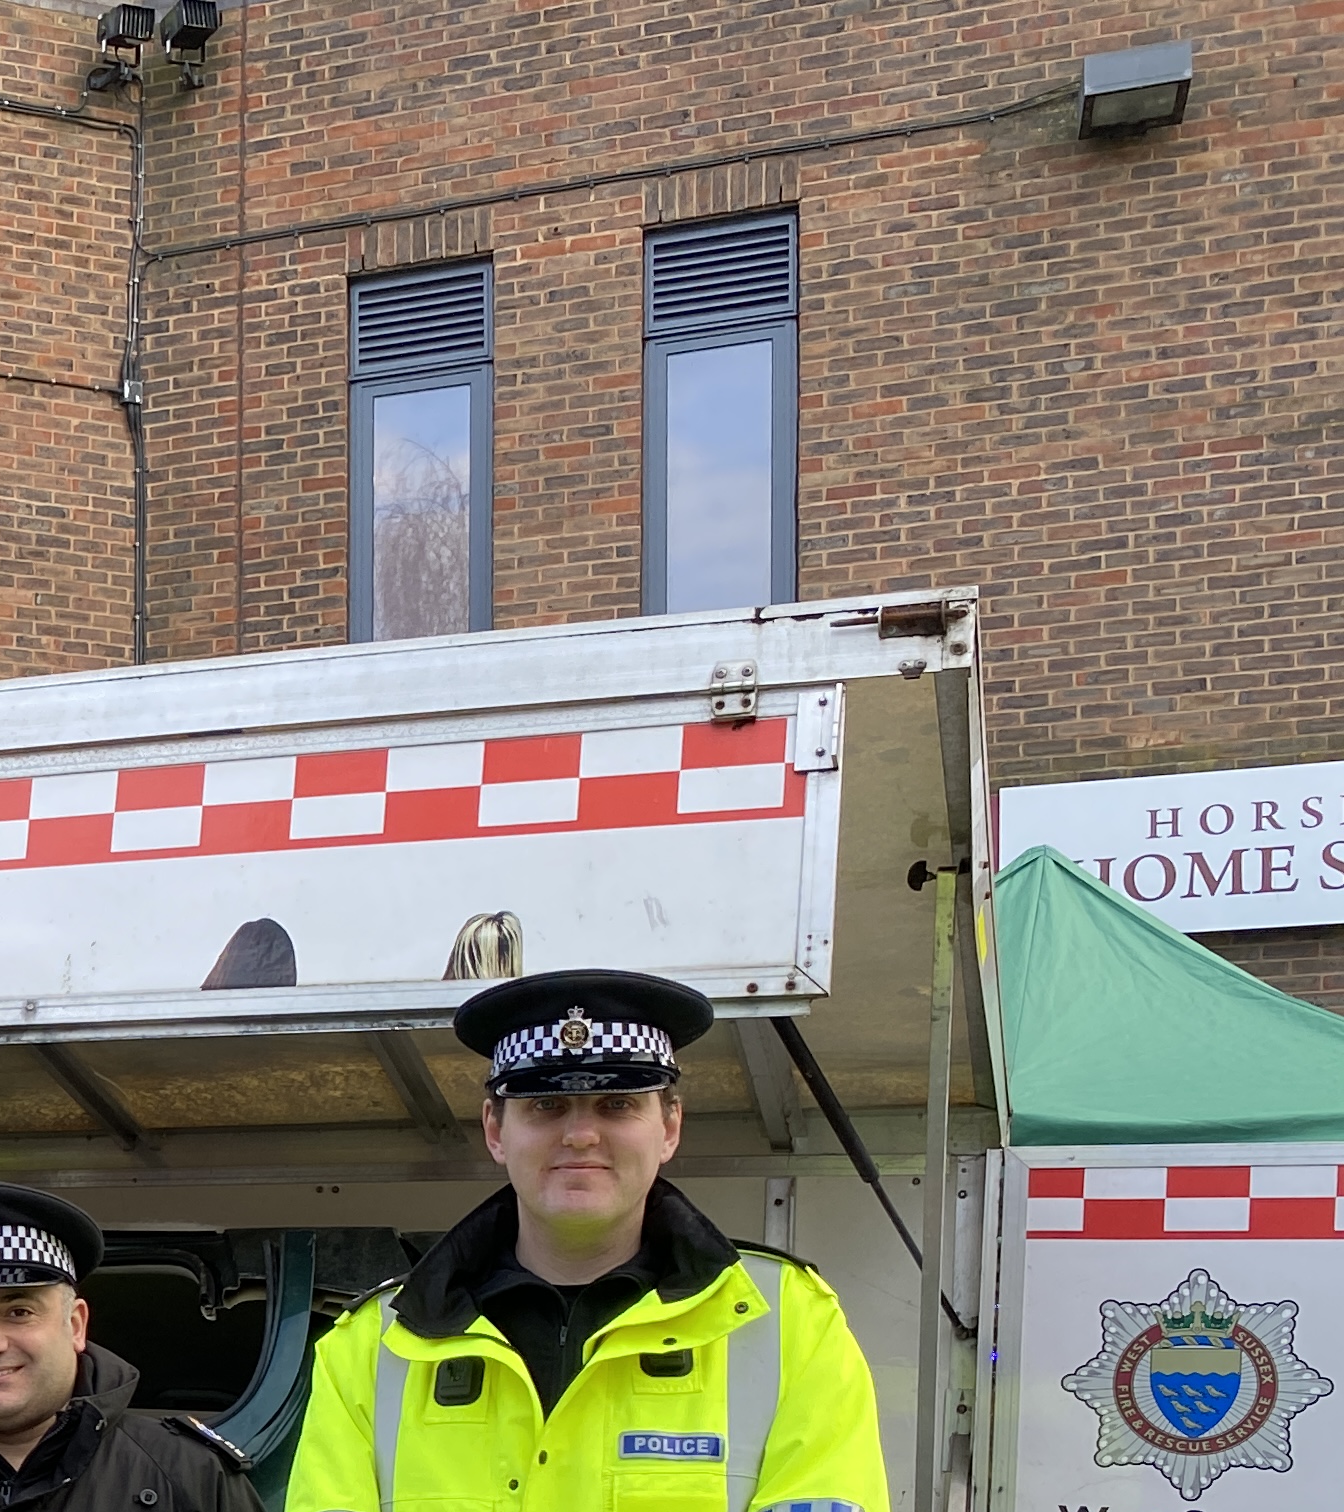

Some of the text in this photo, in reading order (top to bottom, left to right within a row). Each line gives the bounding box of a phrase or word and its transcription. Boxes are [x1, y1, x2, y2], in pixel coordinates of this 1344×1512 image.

[1146, 795, 1344, 839] HORS
[1120, 1331, 1273, 1385] WEST SUSSEX
[1116, 1384, 1271, 1453] FIRE & RESCUE SERVICE
[634, 1437, 709, 1453] POLICE
